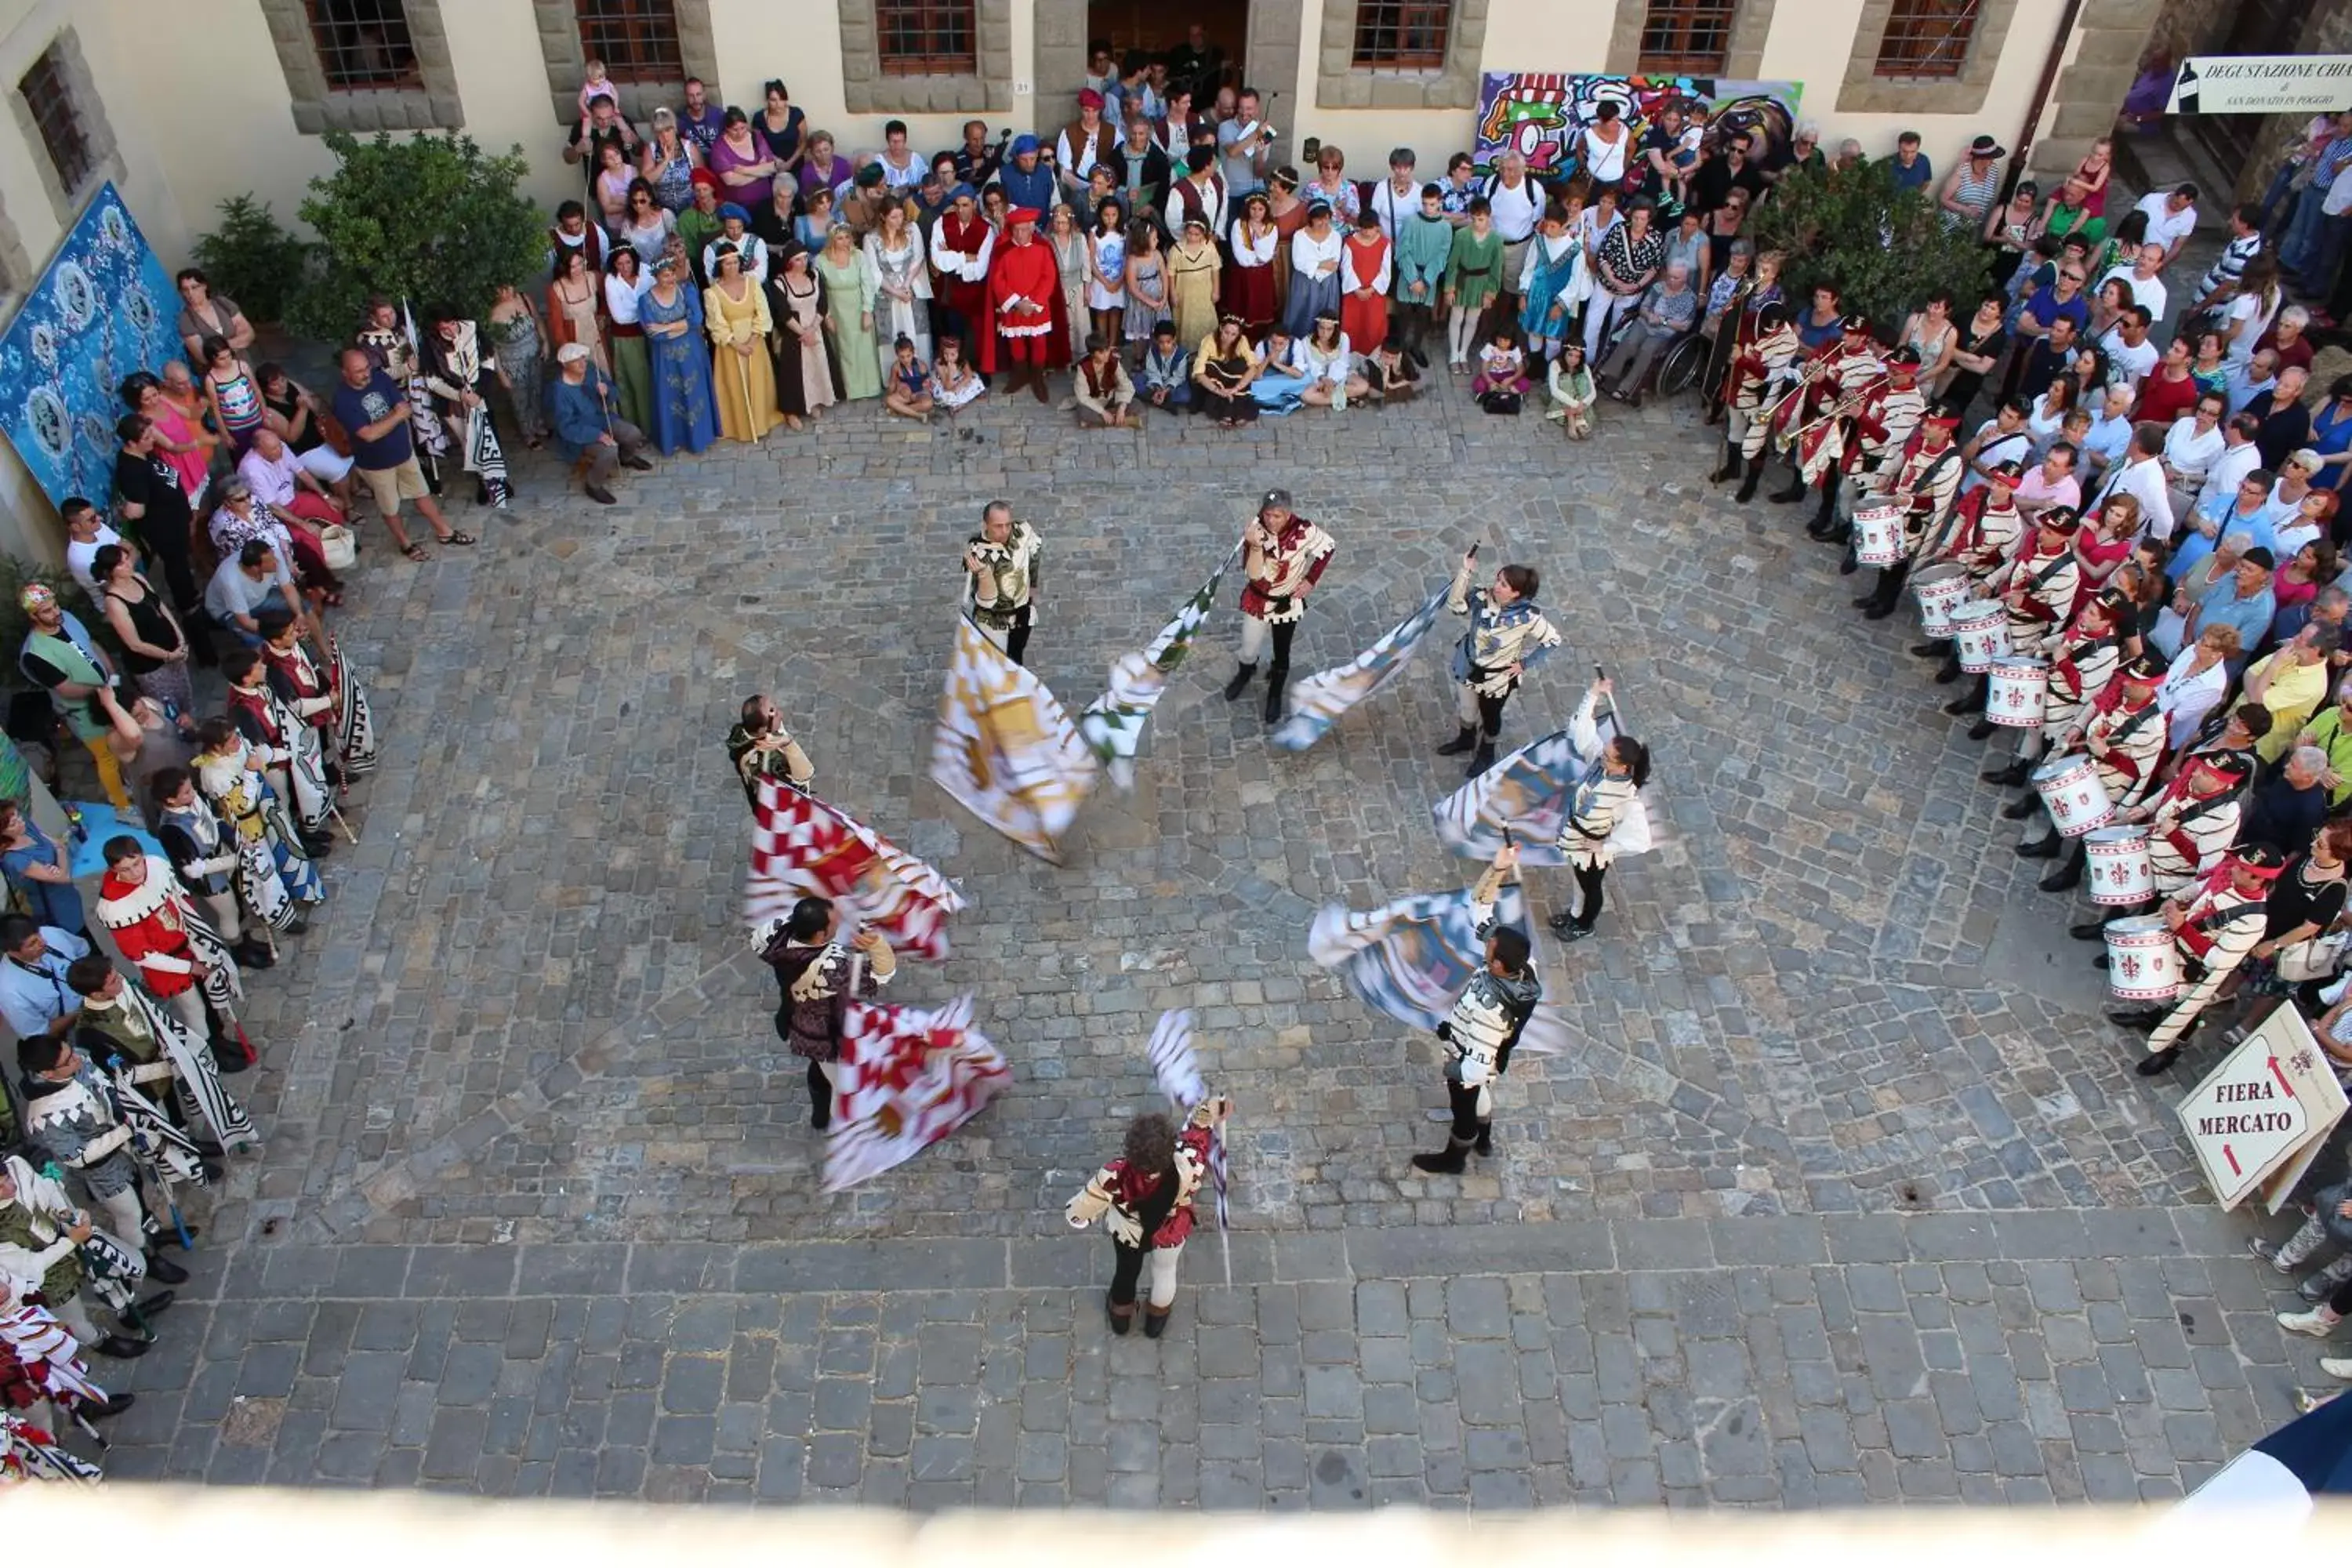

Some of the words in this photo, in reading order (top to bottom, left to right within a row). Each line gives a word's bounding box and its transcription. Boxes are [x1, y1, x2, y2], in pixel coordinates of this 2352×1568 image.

[2205, 63, 2317, 78] DEGUSTAZIONE
[2296, 95, 2334, 105] POGGIO
[2216, 1080, 2274, 1103] FIERA
[2198, 1112, 2292, 1136] MERCATO
